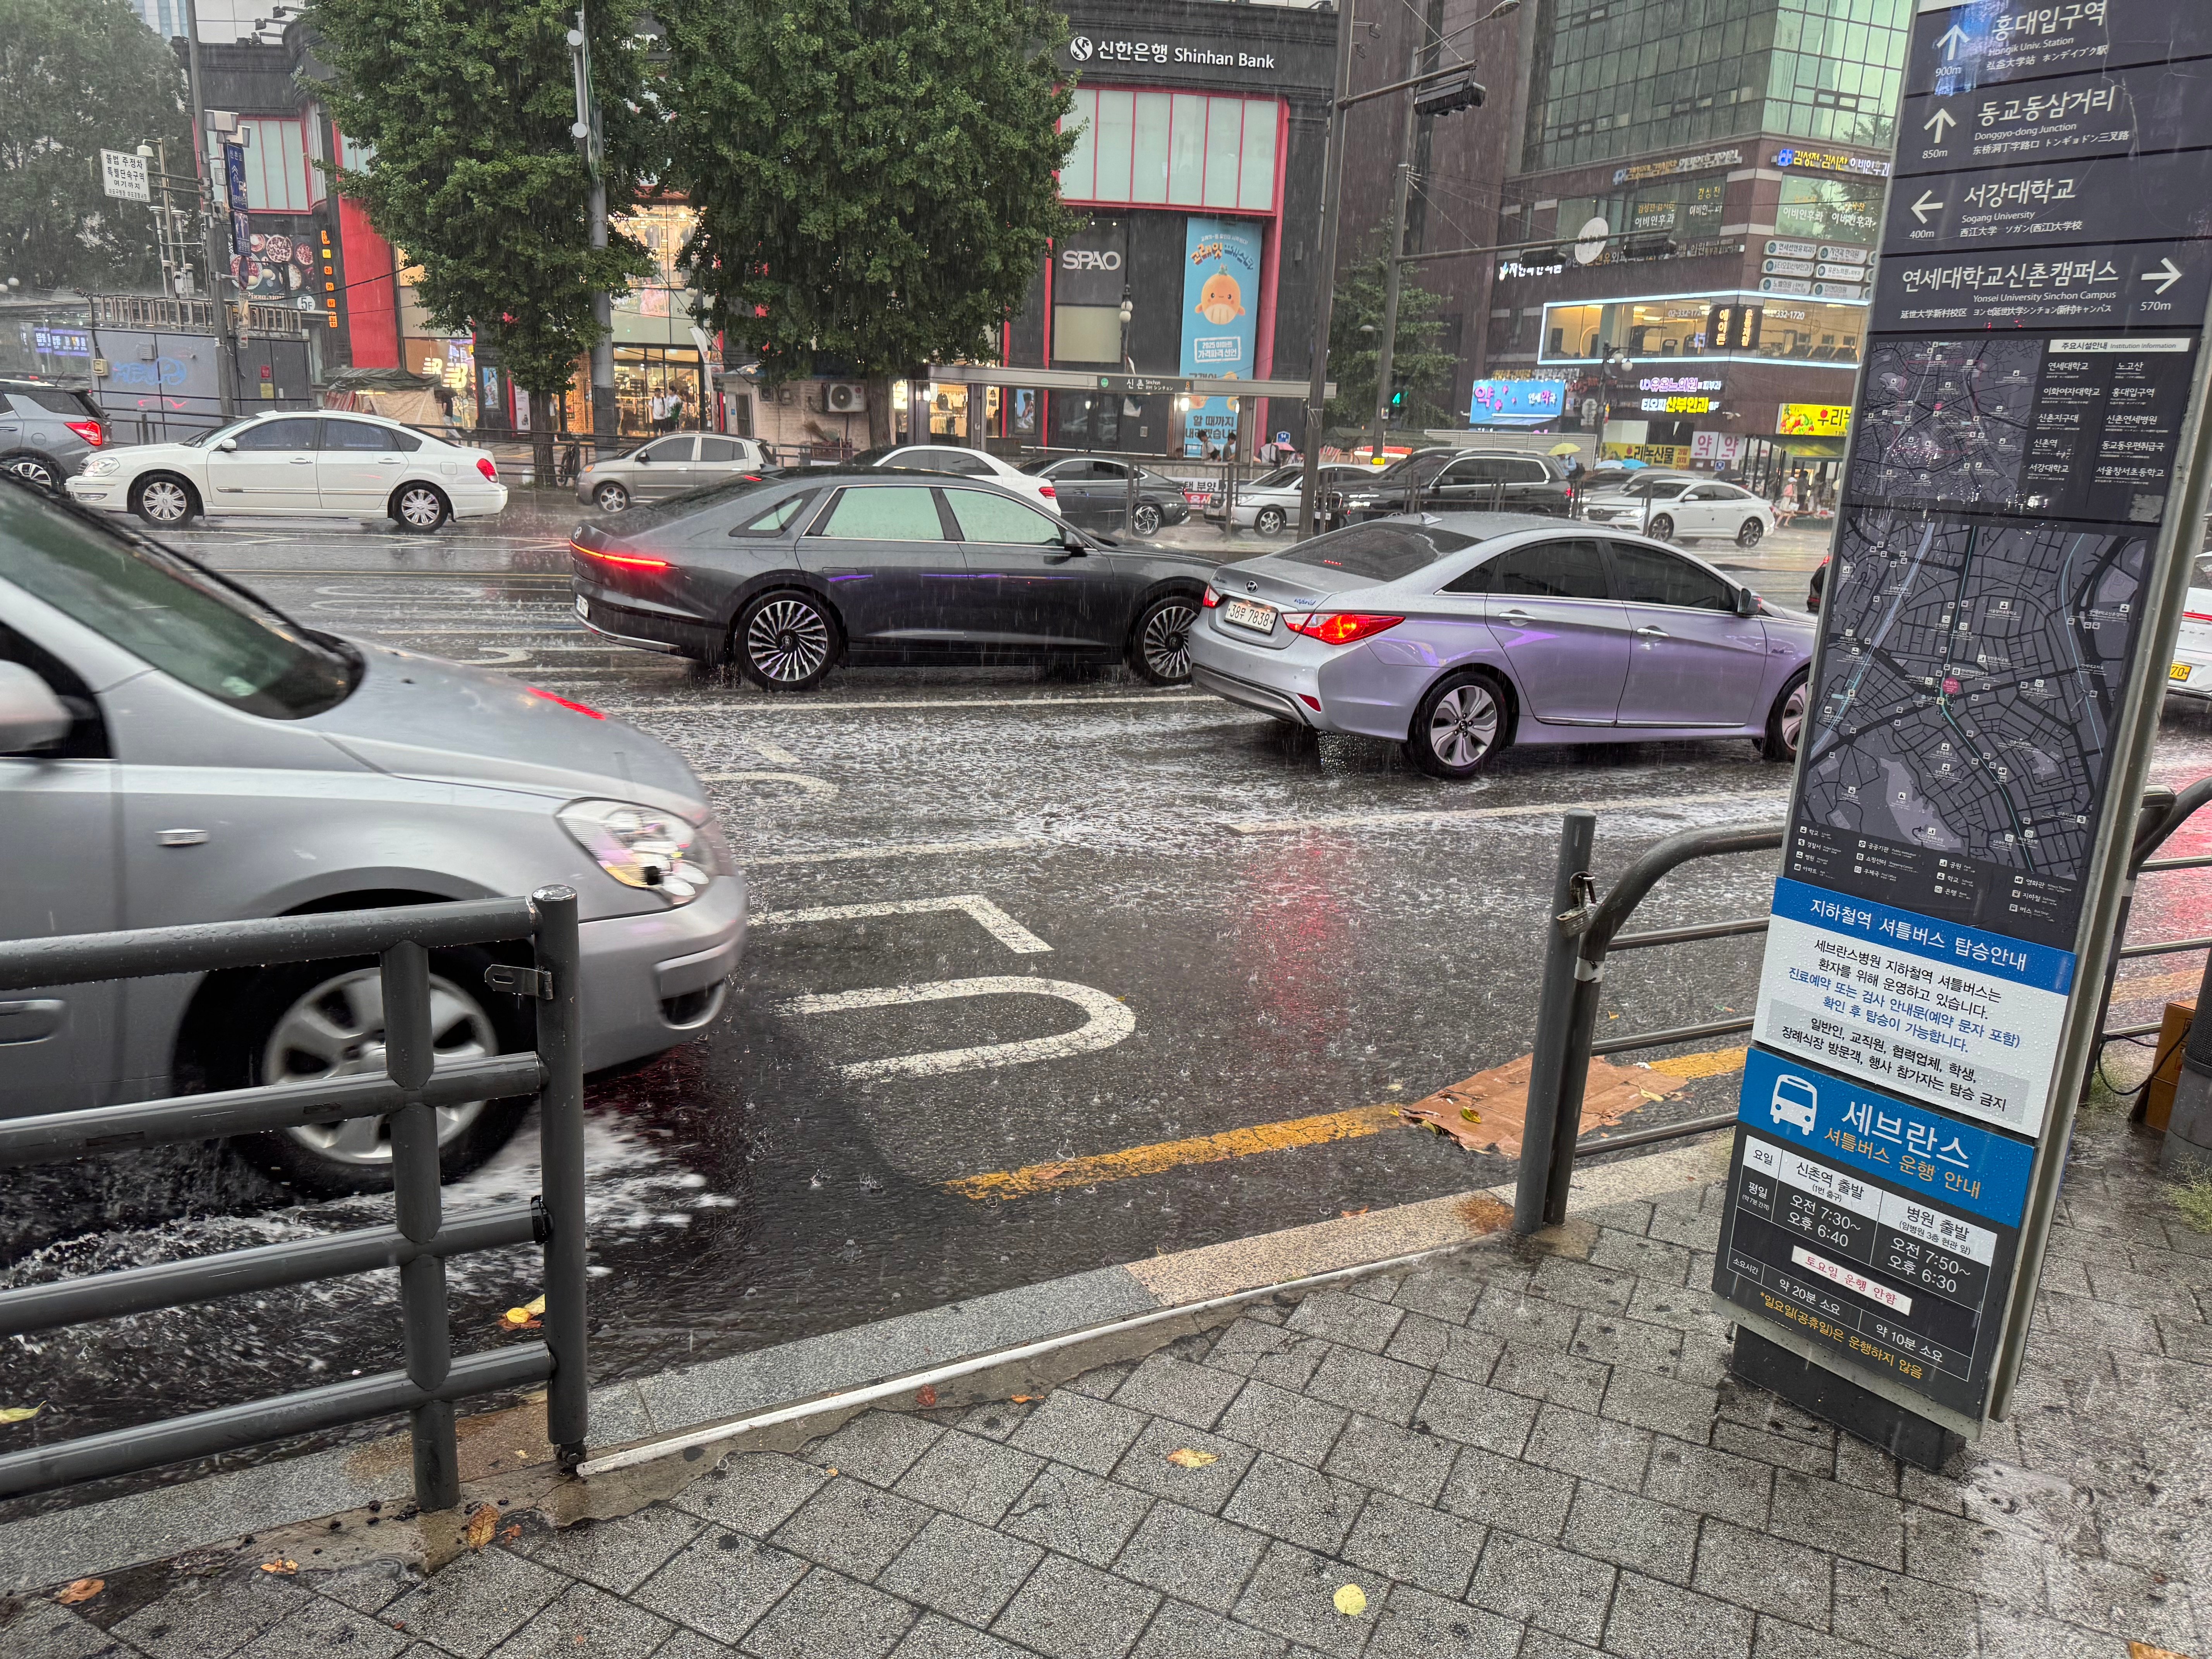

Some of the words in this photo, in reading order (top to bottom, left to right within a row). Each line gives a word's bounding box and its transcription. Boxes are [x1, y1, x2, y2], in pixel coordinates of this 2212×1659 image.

[1991, 0, 2106, 42] 홍대입구역
[1097, 41, 1168, 64] 신한은행
[1174, 47, 1233, 66] Shinhan
[1239, 53, 1274, 69] Bank
[1988, 44, 2019, 57] Hongik
[2020, 41, 2042, 52] Univ.
[2043, 36, 2074, 48] Station
[1935, 65, 1961, 76] 900m
[1977, 87, 2114, 127] 동교동삼거리
[1974, 126, 2038, 141] Donggyo-dong
[2039, 122, 2077, 135] Junction
[106, 154, 119, 165] 불법
[1922, 148, 1948, 158] 850m
[108, 167, 144, 182] 특별단속구역
[114, 180, 140, 189] 여기까지
[1963, 177, 2076, 209] 서강대학교
[1635, 213, 1674, 228] 이비인후과
[1783, 206, 1824, 223] 이비인후과
[1961, 212, 1992, 223] Sogang
[1994, 210, 2035, 222] University
[1909, 229, 1934, 238] 400m
[1960, 226, 1997, 238] 西江大学
[1062, 250, 1121, 270] SPAO
[1190, 242, 1223, 265] 고래잇
[1902, 260, 2119, 294] 연세대학교신촌캠퍼스
[1973, 293, 1999, 303] Yonsei
[2000, 292, 2042, 303] University
[2043, 291, 2079, 301] Sinchon
[2080, 290, 2116, 301] Campus
[2140, 301, 2171, 312] 570m
[1716, 309, 1729, 346] 에이든
[2061, 342, 2108, 350] 주요시설안내
[2047, 361, 2089, 371] 연세대학교
[2116, 362, 2144, 371] 노고산
[1474, 386, 1495, 408] 약
[2043, 387, 2101, 397] 이화여자대학교
[2111, 388, 2155, 398] 홍대입구역
[1206, 416, 1234, 427] 때까지
[2038, 413, 2079, 424] 신촌지구대
[2106, 415, 2157, 426] 신촌연세병원
[1698, 434, 1712, 456] 약
[1724, 436, 1739, 457] 약
[2033, 438, 2058, 448] 신촌역
[2029, 463, 2069, 473] 서강대학교
[2096, 466, 2165, 477] 서울창서초등학교
[1248, 609, 1270, 627] 7838
[1807, 841, 1821, 850] 경찰서
[1868, 843, 1889, 853] 공공기관
[1803, 866, 1817, 874] 아파트
[1865, 856, 1886, 866] 쇼핑센터
[1950, 861, 1962, 870] 공원
[1863, 869, 1879, 878] 우체국
[1947, 875, 1959, 883] 학교
[1945, 888, 1957, 896] 은행
[2026, 878, 2045, 888] 영화관
[2022, 893, 2041, 902] 지하철
[1810, 898, 1872, 931] 지하철역
[1879, 918, 1946, 950] 셔틀버스
[1955, 937, 2027, 972] 탑승안내
[1814, 938, 1882, 968] 세브란스병원
[1885, 958, 1934, 984] 지하철역
[1938, 974, 2002, 1003] 셔틀버스는
[1817, 957, 1852, 979] 환자를
[1856, 970, 1879, 988] 위해
[1882, 977, 1930, 1003] 운영하고
[1936, 993, 1989, 1021] 있습니다.
[1788, 967, 1832, 991] 진료예약
[1835, 981, 1858, 998] 또는
[1862, 989, 1886, 1007] 검사
[1890, 997, 1954, 1030] 안내문(예약
[1958, 1018, 1985, 1038] 문자
[1988, 1029, 2021, 1049] 포함)
[1823, 996, 1846, 1013] 확인
[1850, 1003, 1861, 1018] 후
[1866, 1009, 1901, 1032] 탑승이
[1905, 1022, 1970, 1054] 가능합니다.
[1810, 1018, 1845, 1041] 일반인,
[1850, 1030, 1887, 1055] 교직원,
[1893, 1044, 1942, 1073] 협력업체,
[1949, 1063, 1977, 1085] 학생,
[1781, 1026, 1825, 1052] 장례식장
[1828, 1042, 1863, 1065] 방문객,
[1869, 1056, 1893, 1075] 행사
[1896, 1064, 1946, 1092] 참가자는
[1950, 1082, 1975, 1103] 탑승
[1980, 1093, 2007, 1112] 금지
[1841, 1099, 1971, 1170] 세브란스
[1752, 1149, 1774, 1166] 요일
[1824, 1127, 1891, 1165] 셔틀버스
[1898, 1154, 1937, 1183] 운행
[1944, 1171, 1982, 1201] 안내
[1748, 1181, 1768, 1199] 평일
[1795, 1162, 1834, 1188] 신촌역
[1838, 1178, 1865, 1201] 출발
[1812, 1183, 1825, 1194] (1번
[1826, 1189, 1843, 1202] 출구)
[1789, 1194, 1817, 1216] 오전
[1820, 1206, 1861, 1232] 7:30~
[1786, 1211, 1814, 1233] 오후
[1817, 1226, 1849, 1248] 6:40
[1906, 1205, 1936, 1229] 병원
[1939, 1219, 1970, 1242] 출발
[1899, 1220, 1925, 1237] (암병원
[1926, 1230, 1940, 1245] 3층
[1941, 1236, 1958, 1250] 현관
[1960, 1243, 1972, 1256] 앞)
[1732, 1257, 1760, 1275] 소요시간
[1890, 1237, 1920, 1261] 오전
[1925, 1251, 1972, 1277] 7:50~
[1805, 1255, 1839, 1279] 토요일
[1844, 1271, 1868, 1292] 운행
[1873, 1286, 1898, 1305] 안함
[1886, 1254, 1917, 1278] 오후
[1921, 1271, 1957, 1294] 6:30
[1779, 1279, 1791, 1294] 약
[1791, 1285, 1817, 1305] 20분
[1819, 1297, 1841, 1317] 소요
[1875, 1324, 1888, 1340] 약
[1891, 1331, 1917, 1351] 10분
[1919, 1343, 1944, 1364] 소요
[1848, 1335, 1895, 1367] 운행하지
[1899, 1358, 1924, 1380] 않음
